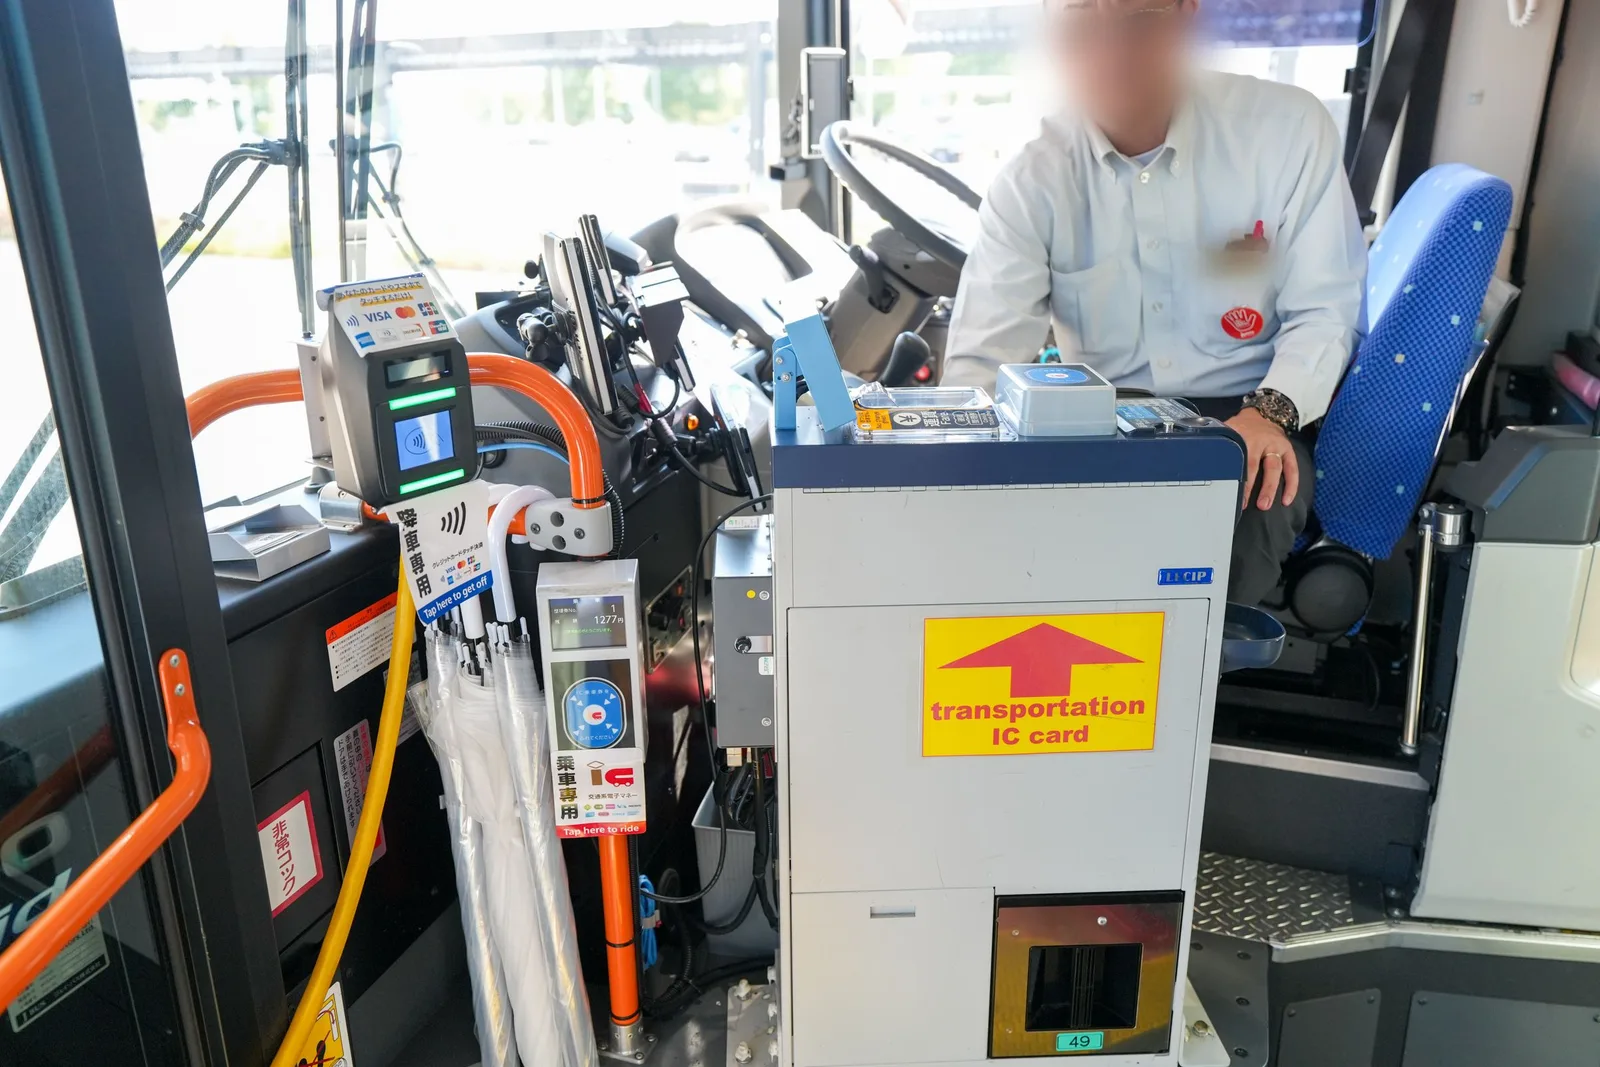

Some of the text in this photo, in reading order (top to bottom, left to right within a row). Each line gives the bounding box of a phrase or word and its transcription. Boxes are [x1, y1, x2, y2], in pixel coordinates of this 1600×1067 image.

[364, 311, 392, 322] VISA
[423, 575, 488, 619] Tap here to get off
[611, 604, 616, 612] 1
[930, 696, 1145, 723] transportation
[992, 725, 1089, 746] IC card
[556, 755, 579, 820] 乗車専用
[588, 792, 638, 800] 交通系電子マネー
[564, 824, 639, 837] Tap here to ride
[272, 819, 296, 896] 非常コック
[1069, 1036, 1090, 1047] 49
